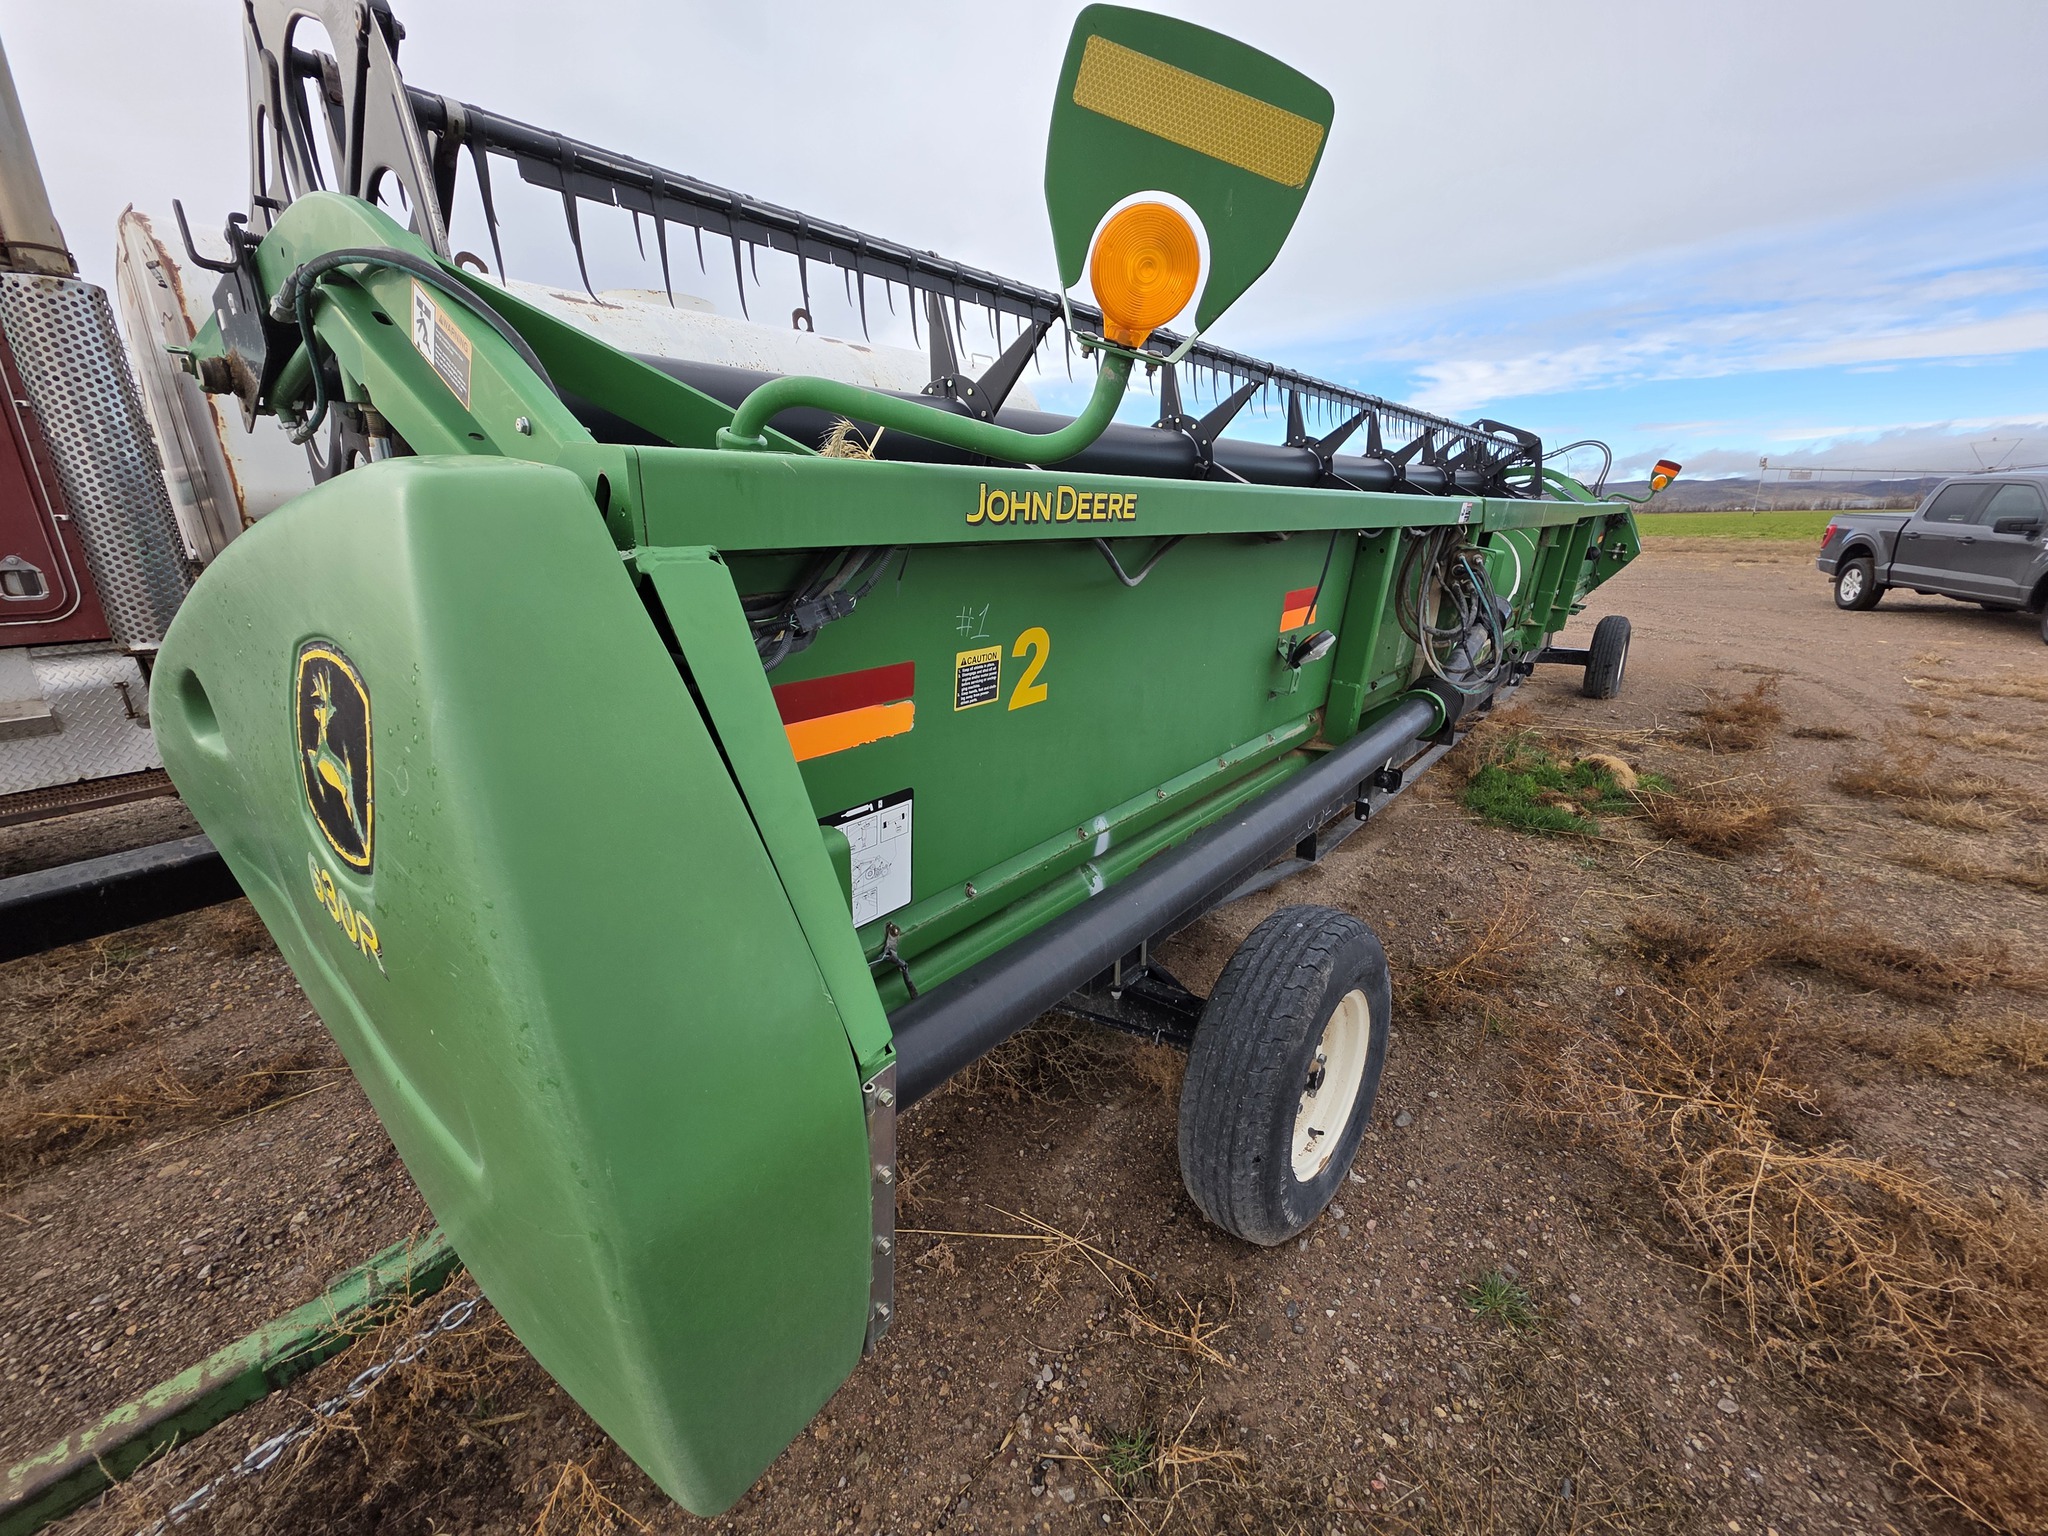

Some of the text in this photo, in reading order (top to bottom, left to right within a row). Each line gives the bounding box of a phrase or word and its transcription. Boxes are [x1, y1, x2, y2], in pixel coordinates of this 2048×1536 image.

[441, 317, 469, 354] WARNING
[966, 482, 1138, 524] JOHN DEERE
[956, 603, 990, 639] #1
[966, 651, 998, 665] CAUTION
[1007, 625, 1051, 712] 2
[308, 851, 389, 981] 630R
